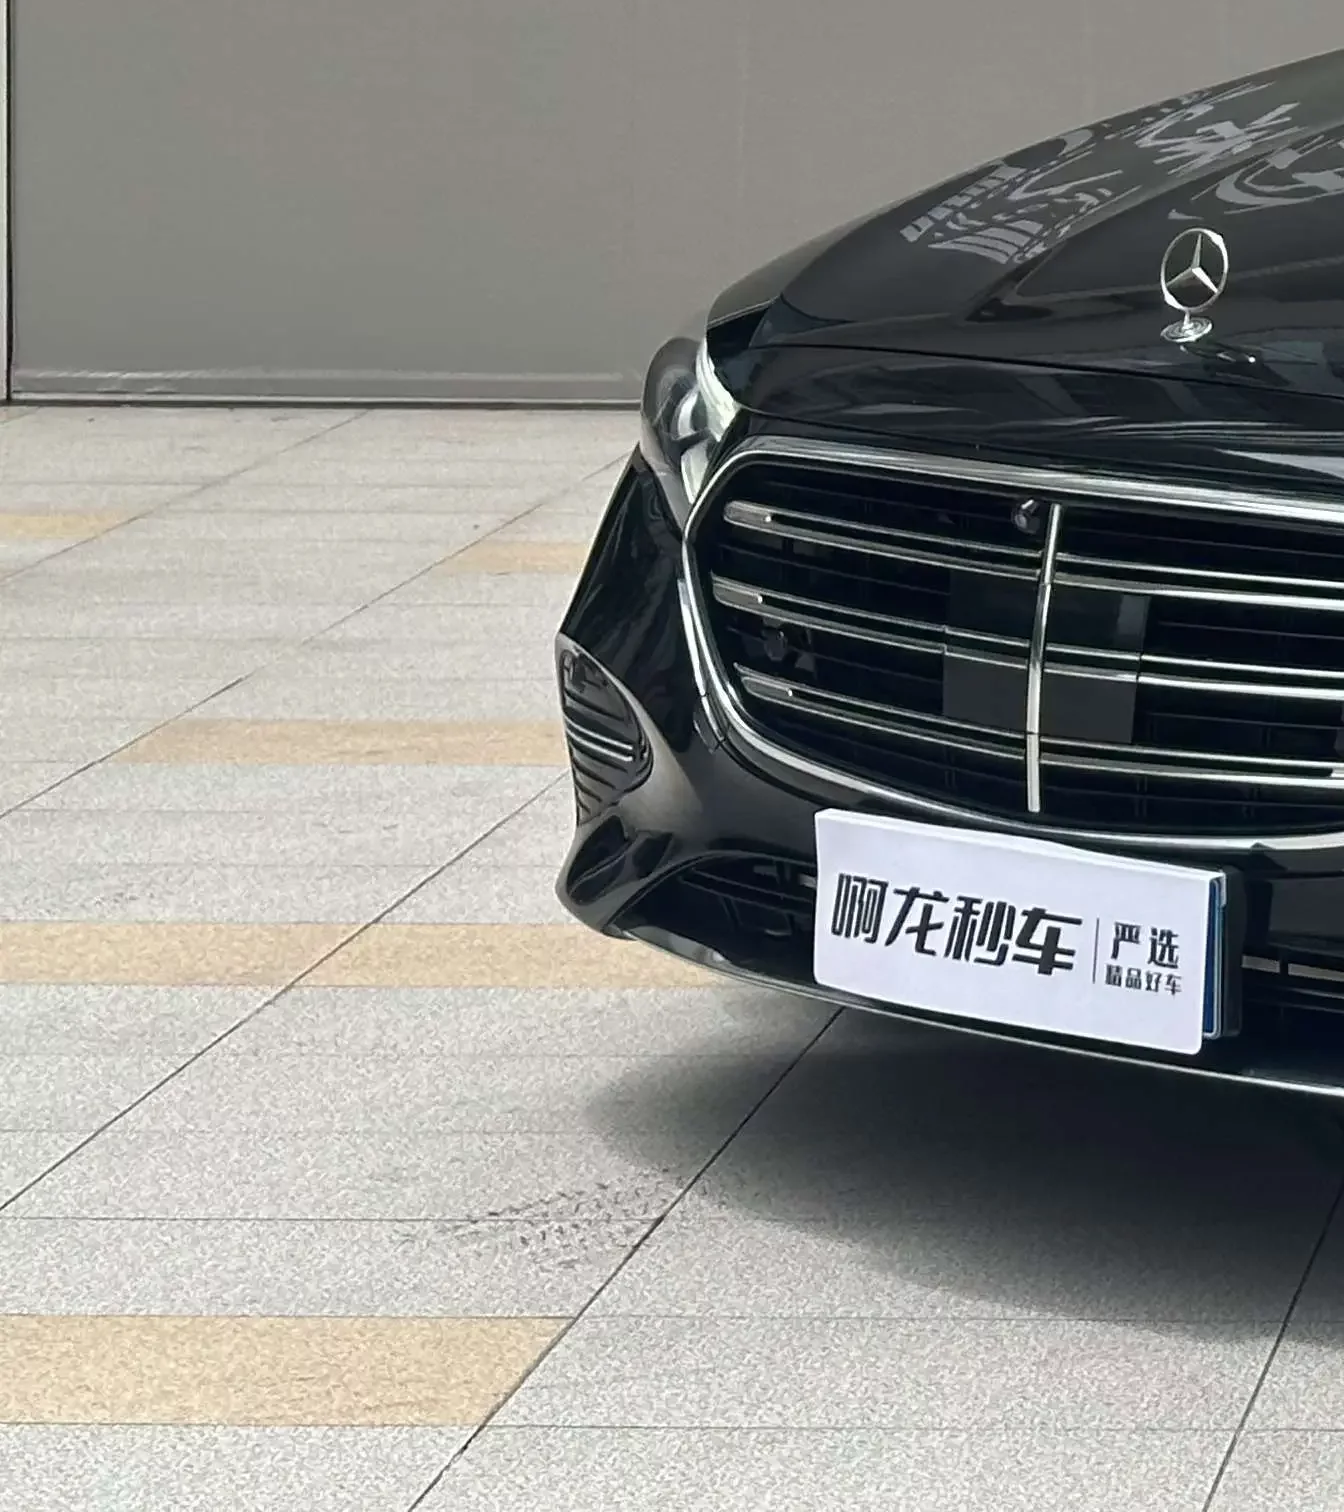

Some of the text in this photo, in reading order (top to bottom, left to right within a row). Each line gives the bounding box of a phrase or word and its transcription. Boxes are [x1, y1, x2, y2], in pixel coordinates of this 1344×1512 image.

[831, 873, 1083, 976] 啊龙秒车
[1110, 921, 1179, 969] 严选
[1104, 963, 1182, 996] 精品好车
